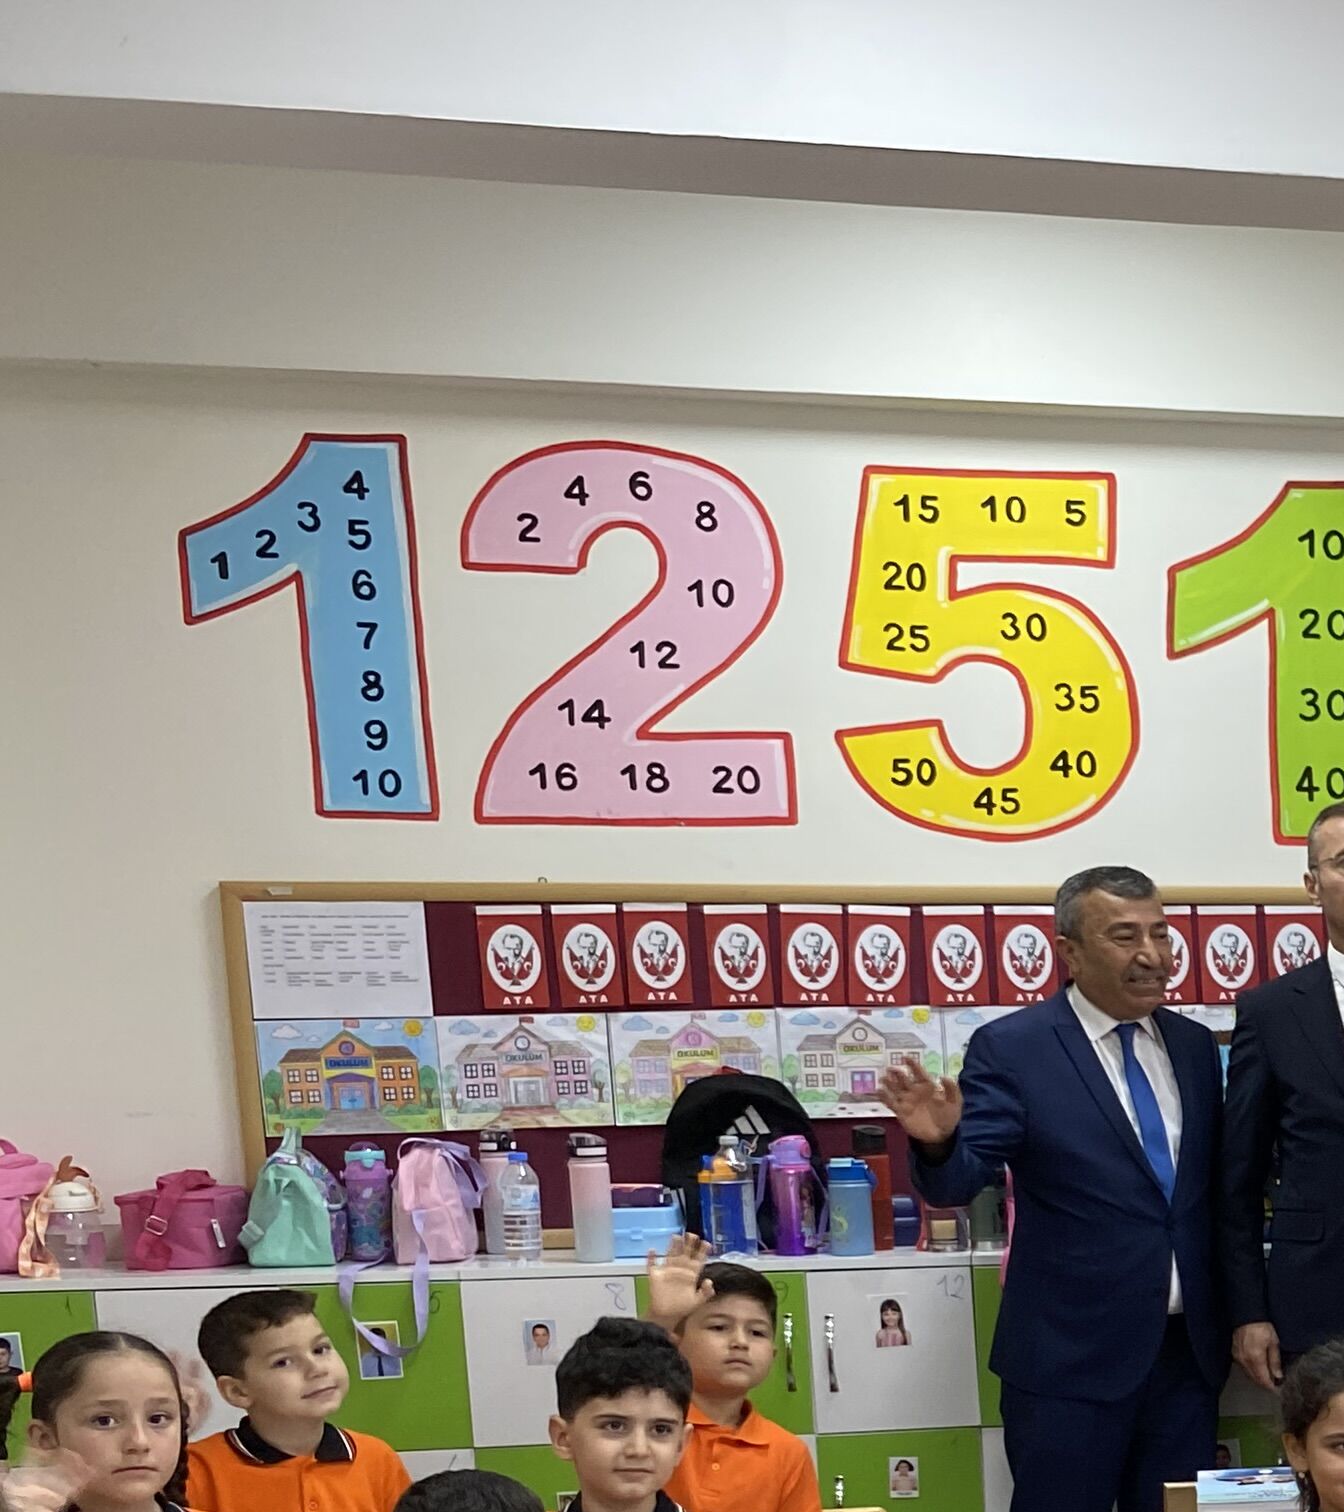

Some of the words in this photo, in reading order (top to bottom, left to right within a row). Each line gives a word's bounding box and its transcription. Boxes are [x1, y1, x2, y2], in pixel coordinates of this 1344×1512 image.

[342, 470, 370, 501] 4
[563, 475, 590, 507] 4
[628, 470, 653, 501] 6
[297, 501, 321, 533] 3
[695, 501, 719, 532] 8
[893, 494, 939, 523] 15
[980, 495, 1027, 523] 10
[1065, 500, 1086, 527] 5
[347, 519, 372, 551] 5
[516, 512, 542, 543] 2
[255, 529, 280, 559] 2
[209, 550, 230, 581] 1
[882, 561, 928, 591] 20
[351, 569, 377, 601] 6
[687, 578, 736, 608] 10
[356, 621, 379, 651] 7
[882, 623, 931, 653] 25
[1000, 612, 1048, 642] 30
[629, 640, 681, 670] 12
[361, 670, 385, 702] 8
[1053, 683, 1101, 714] 35
[557, 698, 612, 730] 14
[364, 719, 389, 751] 9
[528, 762, 578, 791] 16
[620, 762, 670, 794] 18
[711, 765, 760, 794] 20
[890, 758, 938, 787] 50
[1050, 750, 1098, 779] 40
[352, 769, 402, 798] 10
[972, 786, 1022, 817] 45
[503, 995, 533, 1005] ATA
[579, 994, 608, 1004] ATA
[647, 991, 678, 1001] ATA
[729, 993, 758, 1003] ATA
[800, 991, 830, 1002] ATA
[866, 993, 896, 1003] ATA
[946, 993, 976, 1003] ATA
[1016, 992, 1045, 1002] ATA
[505, 1053, 545, 1063] OKULUM
